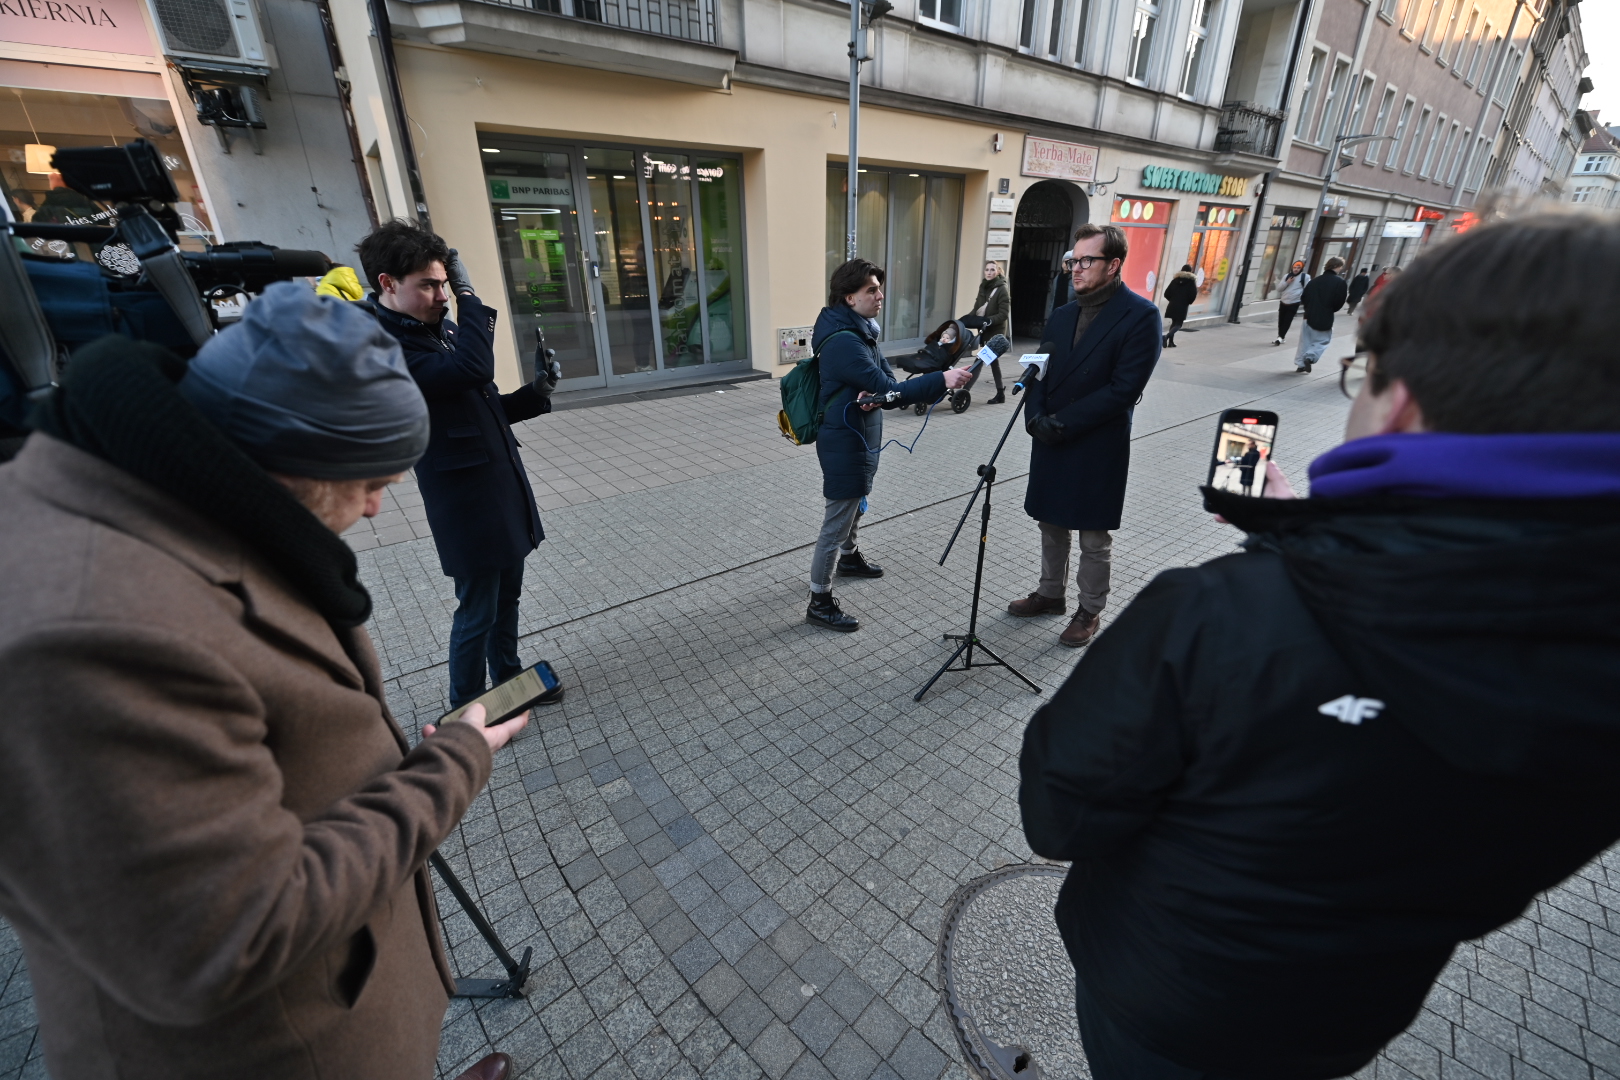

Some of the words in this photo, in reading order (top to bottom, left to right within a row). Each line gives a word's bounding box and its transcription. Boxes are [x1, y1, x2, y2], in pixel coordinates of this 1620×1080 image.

[1032, 142, 1063, 161] Yerba
[1068, 147, 1092, 165] Mate
[511, 186, 531, 195] BNP
[533, 187, 570, 196] PARIBAS
[1141, 164, 1180, 189] SWEET
[1179, 170, 1222, 195] FACTORY
[668, 254, 689, 356] bankomat
[1318, 694, 1386, 725] 4F
